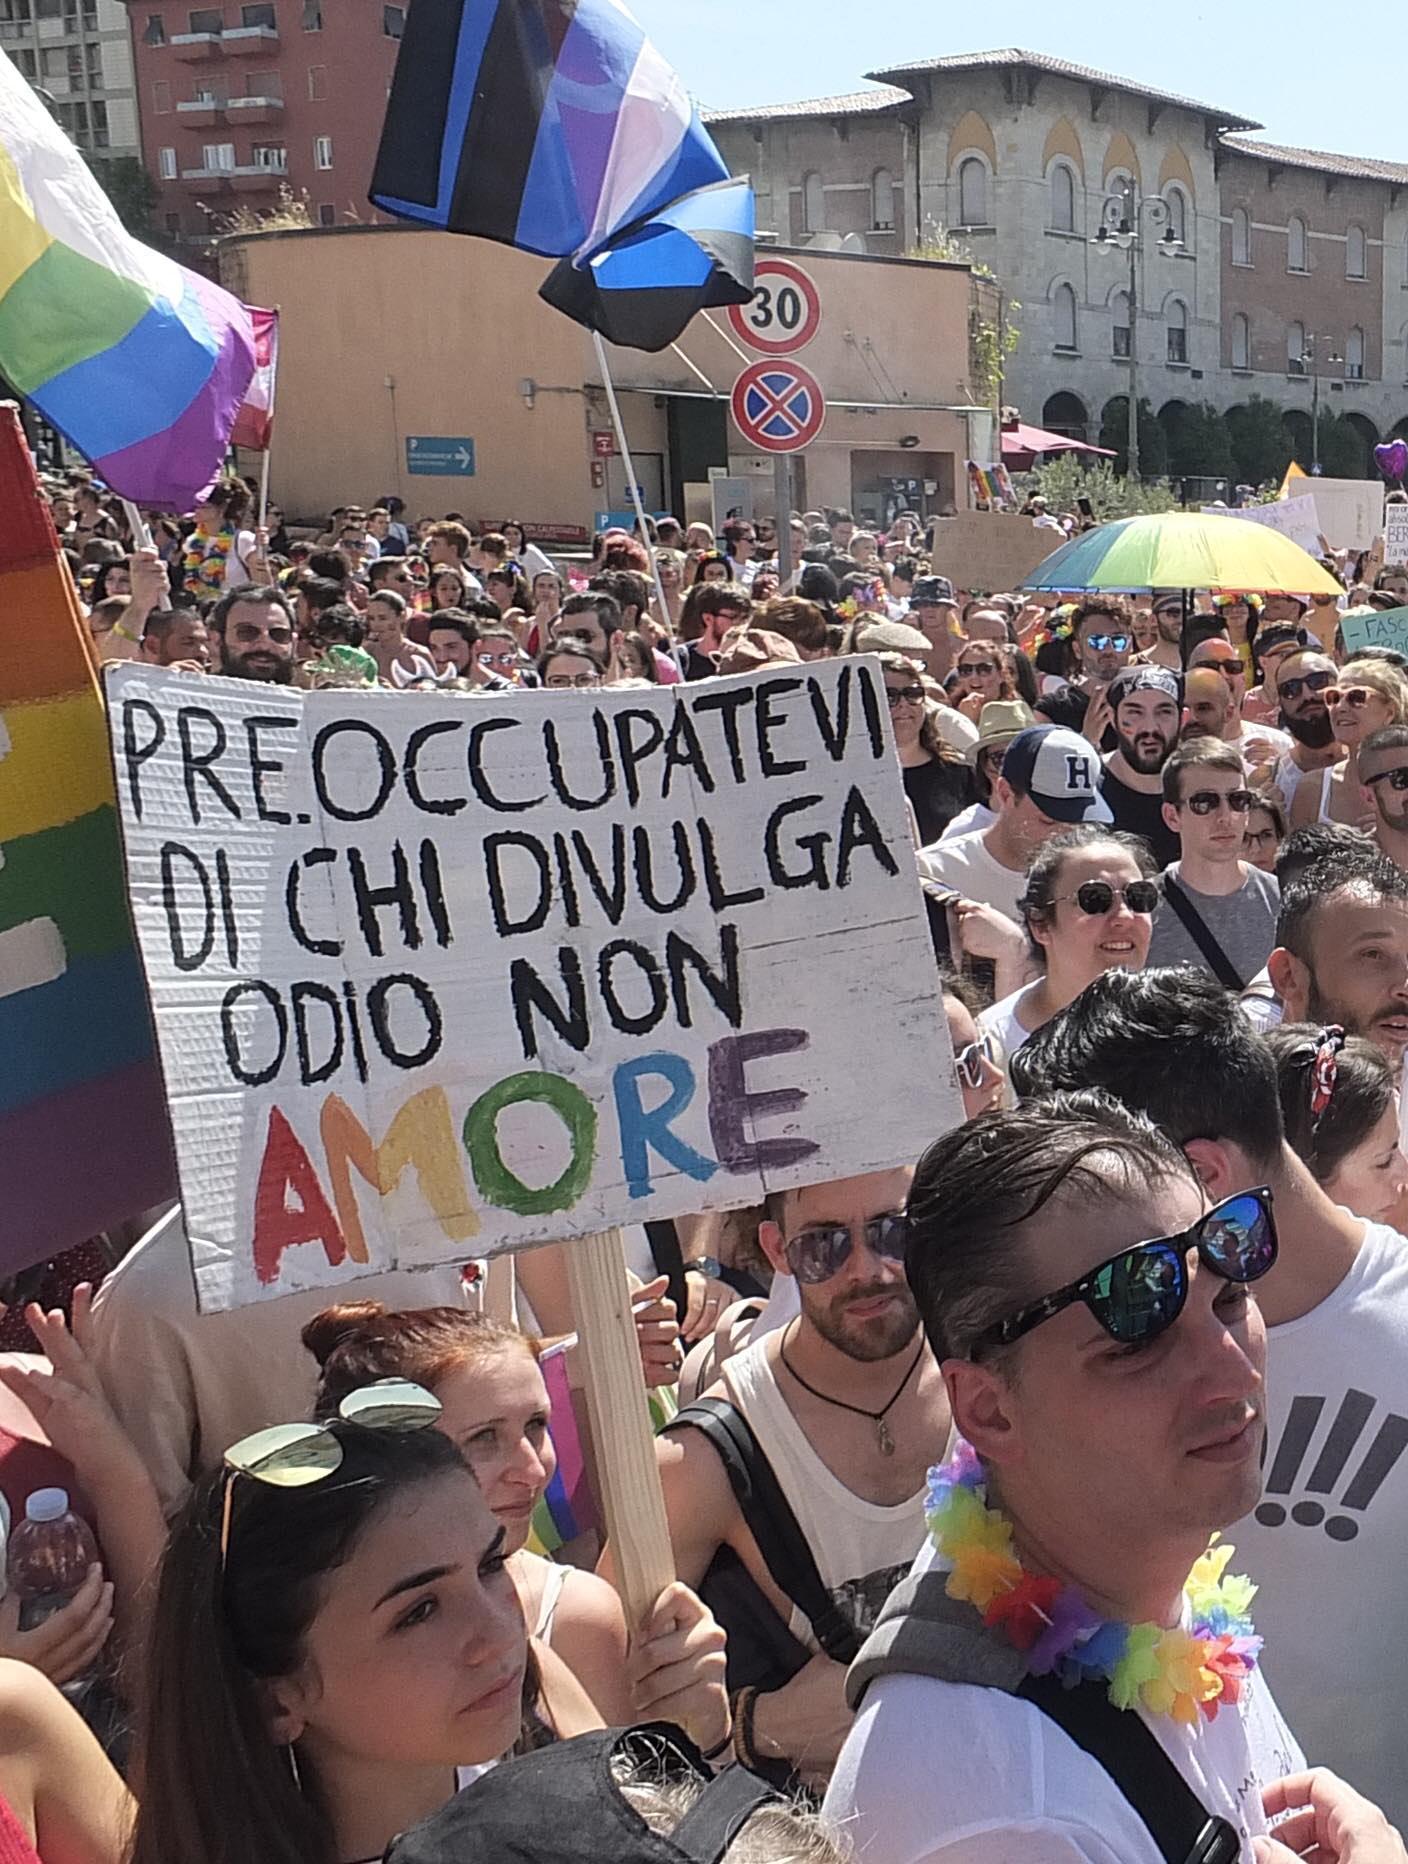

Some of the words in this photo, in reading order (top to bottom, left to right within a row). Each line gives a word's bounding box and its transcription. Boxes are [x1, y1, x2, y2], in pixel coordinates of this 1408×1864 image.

[750, 286, 801, 329] 30
[601, 515, 609, 527] P
[1066, 756, 1091, 789] H
[159, 840, 238, 972] DI
[286, 836, 454, 958] CHI
[483, 785, 899, 938] DIVULGA
[221, 970, 443, 1087] ODIO
[511, 924, 742, 1060] NON
[252, 1027, 822, 1286] AMORE
